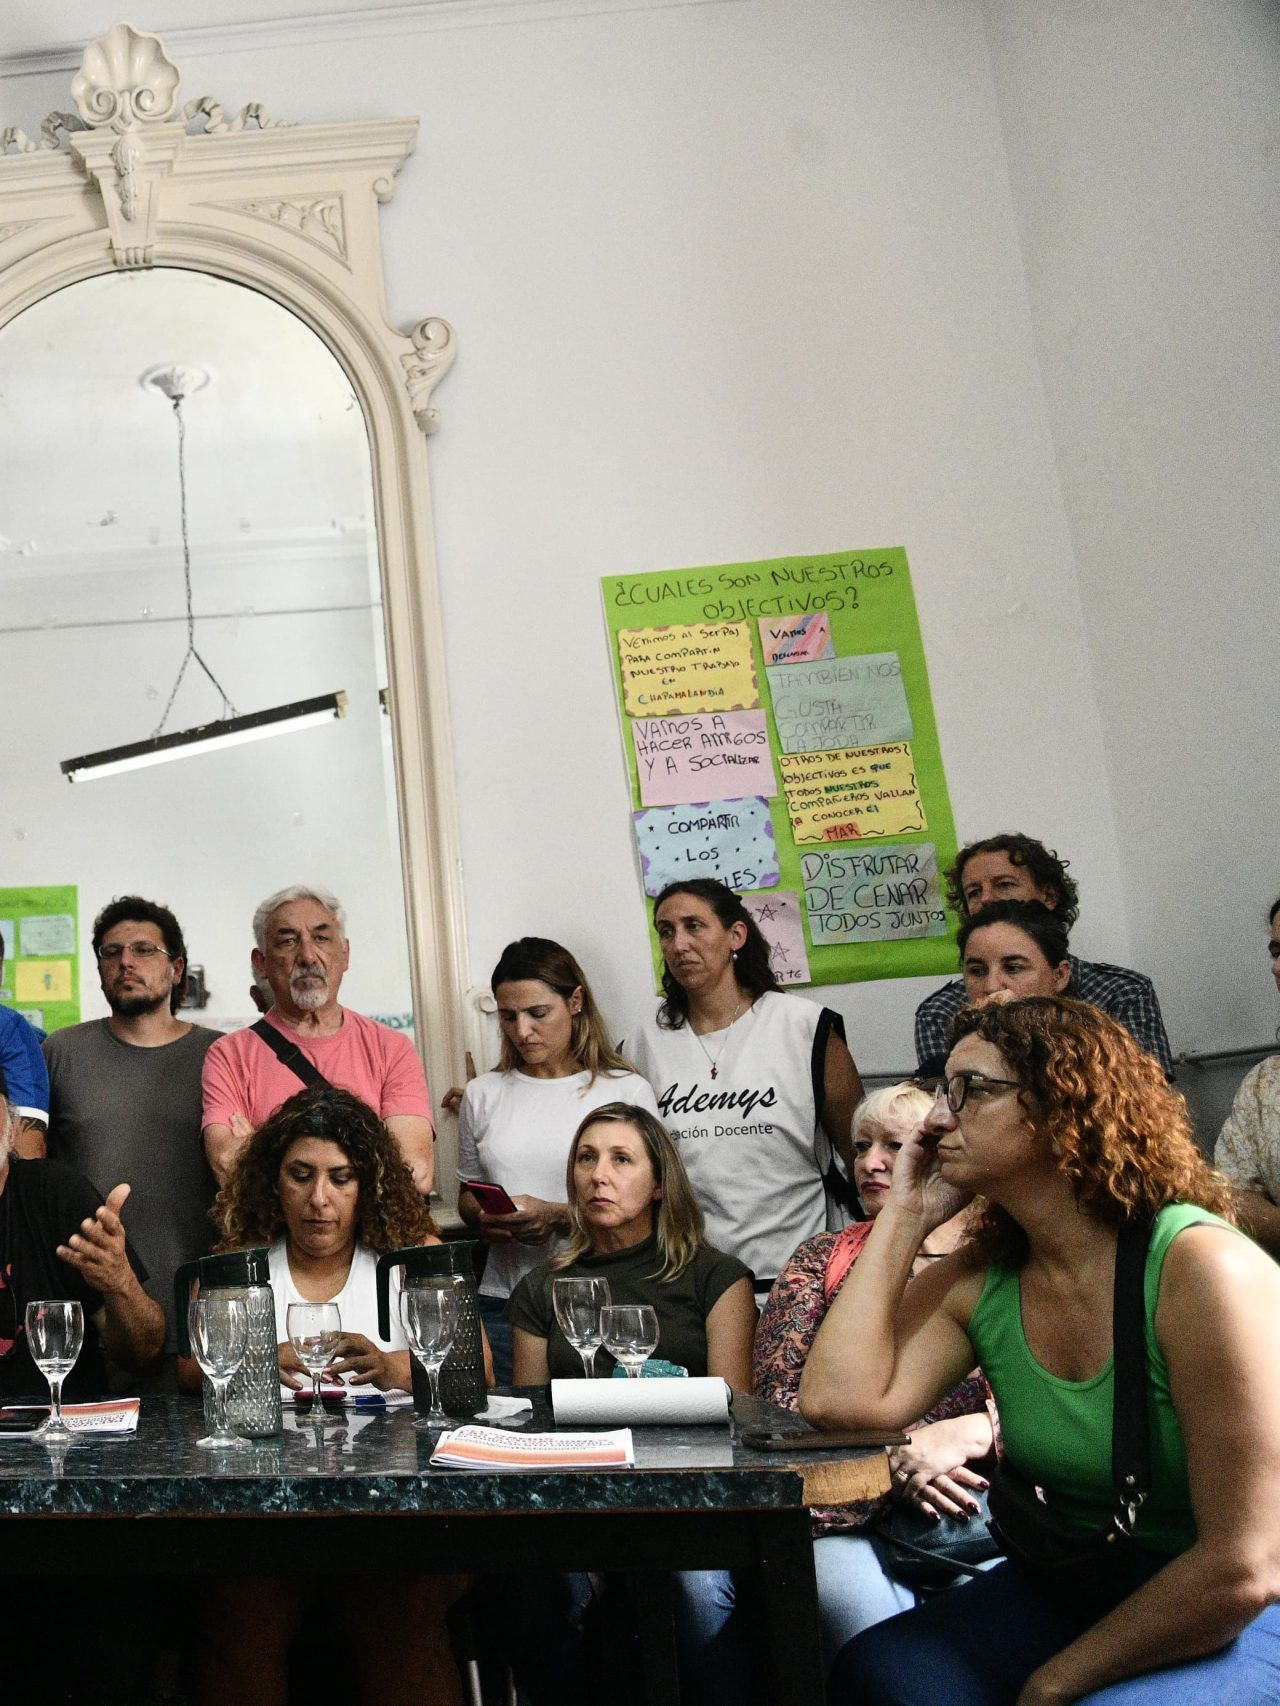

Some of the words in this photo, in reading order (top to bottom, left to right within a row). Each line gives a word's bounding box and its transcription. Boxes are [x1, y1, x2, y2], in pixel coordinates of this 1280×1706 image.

[720, 573, 761, 590] SON
[771, 559, 893, 586] NUESTROS
[775, 695, 842, 720] GUSTA
[635, 717, 704, 740] VAMOS
[711, 715, 726, 730] A
[645, 757, 656, 781] Y
[666, 756, 679, 775] A
[825, 752, 841, 762] DE
[826, 823, 861, 840] MAR
[686, 847, 720, 862] LOS
[804, 885, 845, 911] DE
[853, 878, 928, 908] CENAR
[809, 912, 881, 932] TODOS
[885, 910, 946, 929] JUNTOS
[658, 1082, 778, 1119] Ademys
[714, 1122, 773, 1137] Docente
